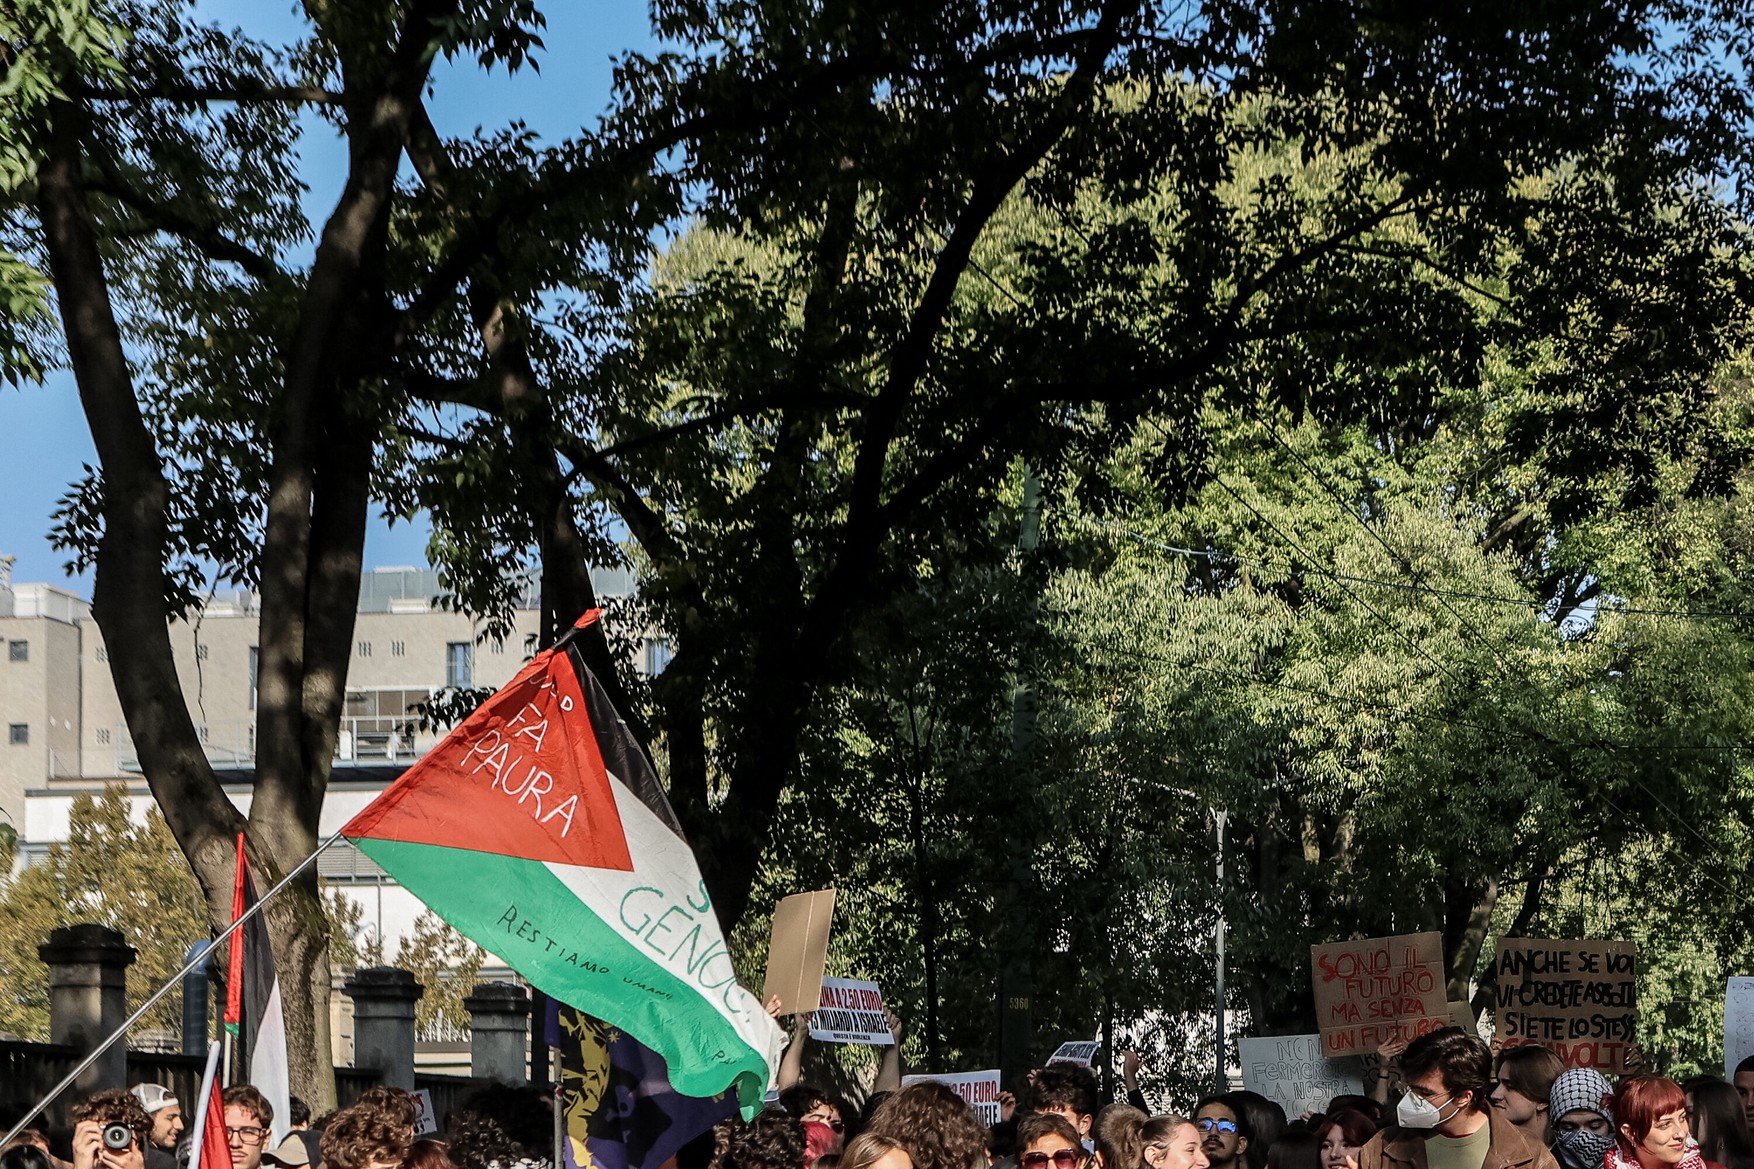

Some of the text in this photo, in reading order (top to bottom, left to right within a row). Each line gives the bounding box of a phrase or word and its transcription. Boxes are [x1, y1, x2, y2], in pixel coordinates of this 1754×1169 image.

[507, 702, 549, 752] FA
[461, 730, 578, 837] PAURA
[497, 904, 610, 975] RESTIAMO
[1319, 947, 1426, 982] SONO IL
[1500, 949, 1634, 975] ANCHE SE VOI
[1345, 971, 1434, 999] FUTURO
[1496, 984, 1514, 1008] VI
[860, 989, 883, 1011] EURO
[1332, 998, 1425, 1022] MA SENZA
[818, 1010, 854, 1032] MILIARDI
[857, 1012, 889, 1034] ISRAELE
[1504, 1012, 1565, 1040] SIETE
[1568, 1017, 1590, 1039] LO
[1277, 1038, 1322, 1061] NON
[1328, 1029, 1355, 1051] UN
[974, 1080, 997, 1103] EURO
[1262, 1080, 1352, 1100] LA NOSTRA
